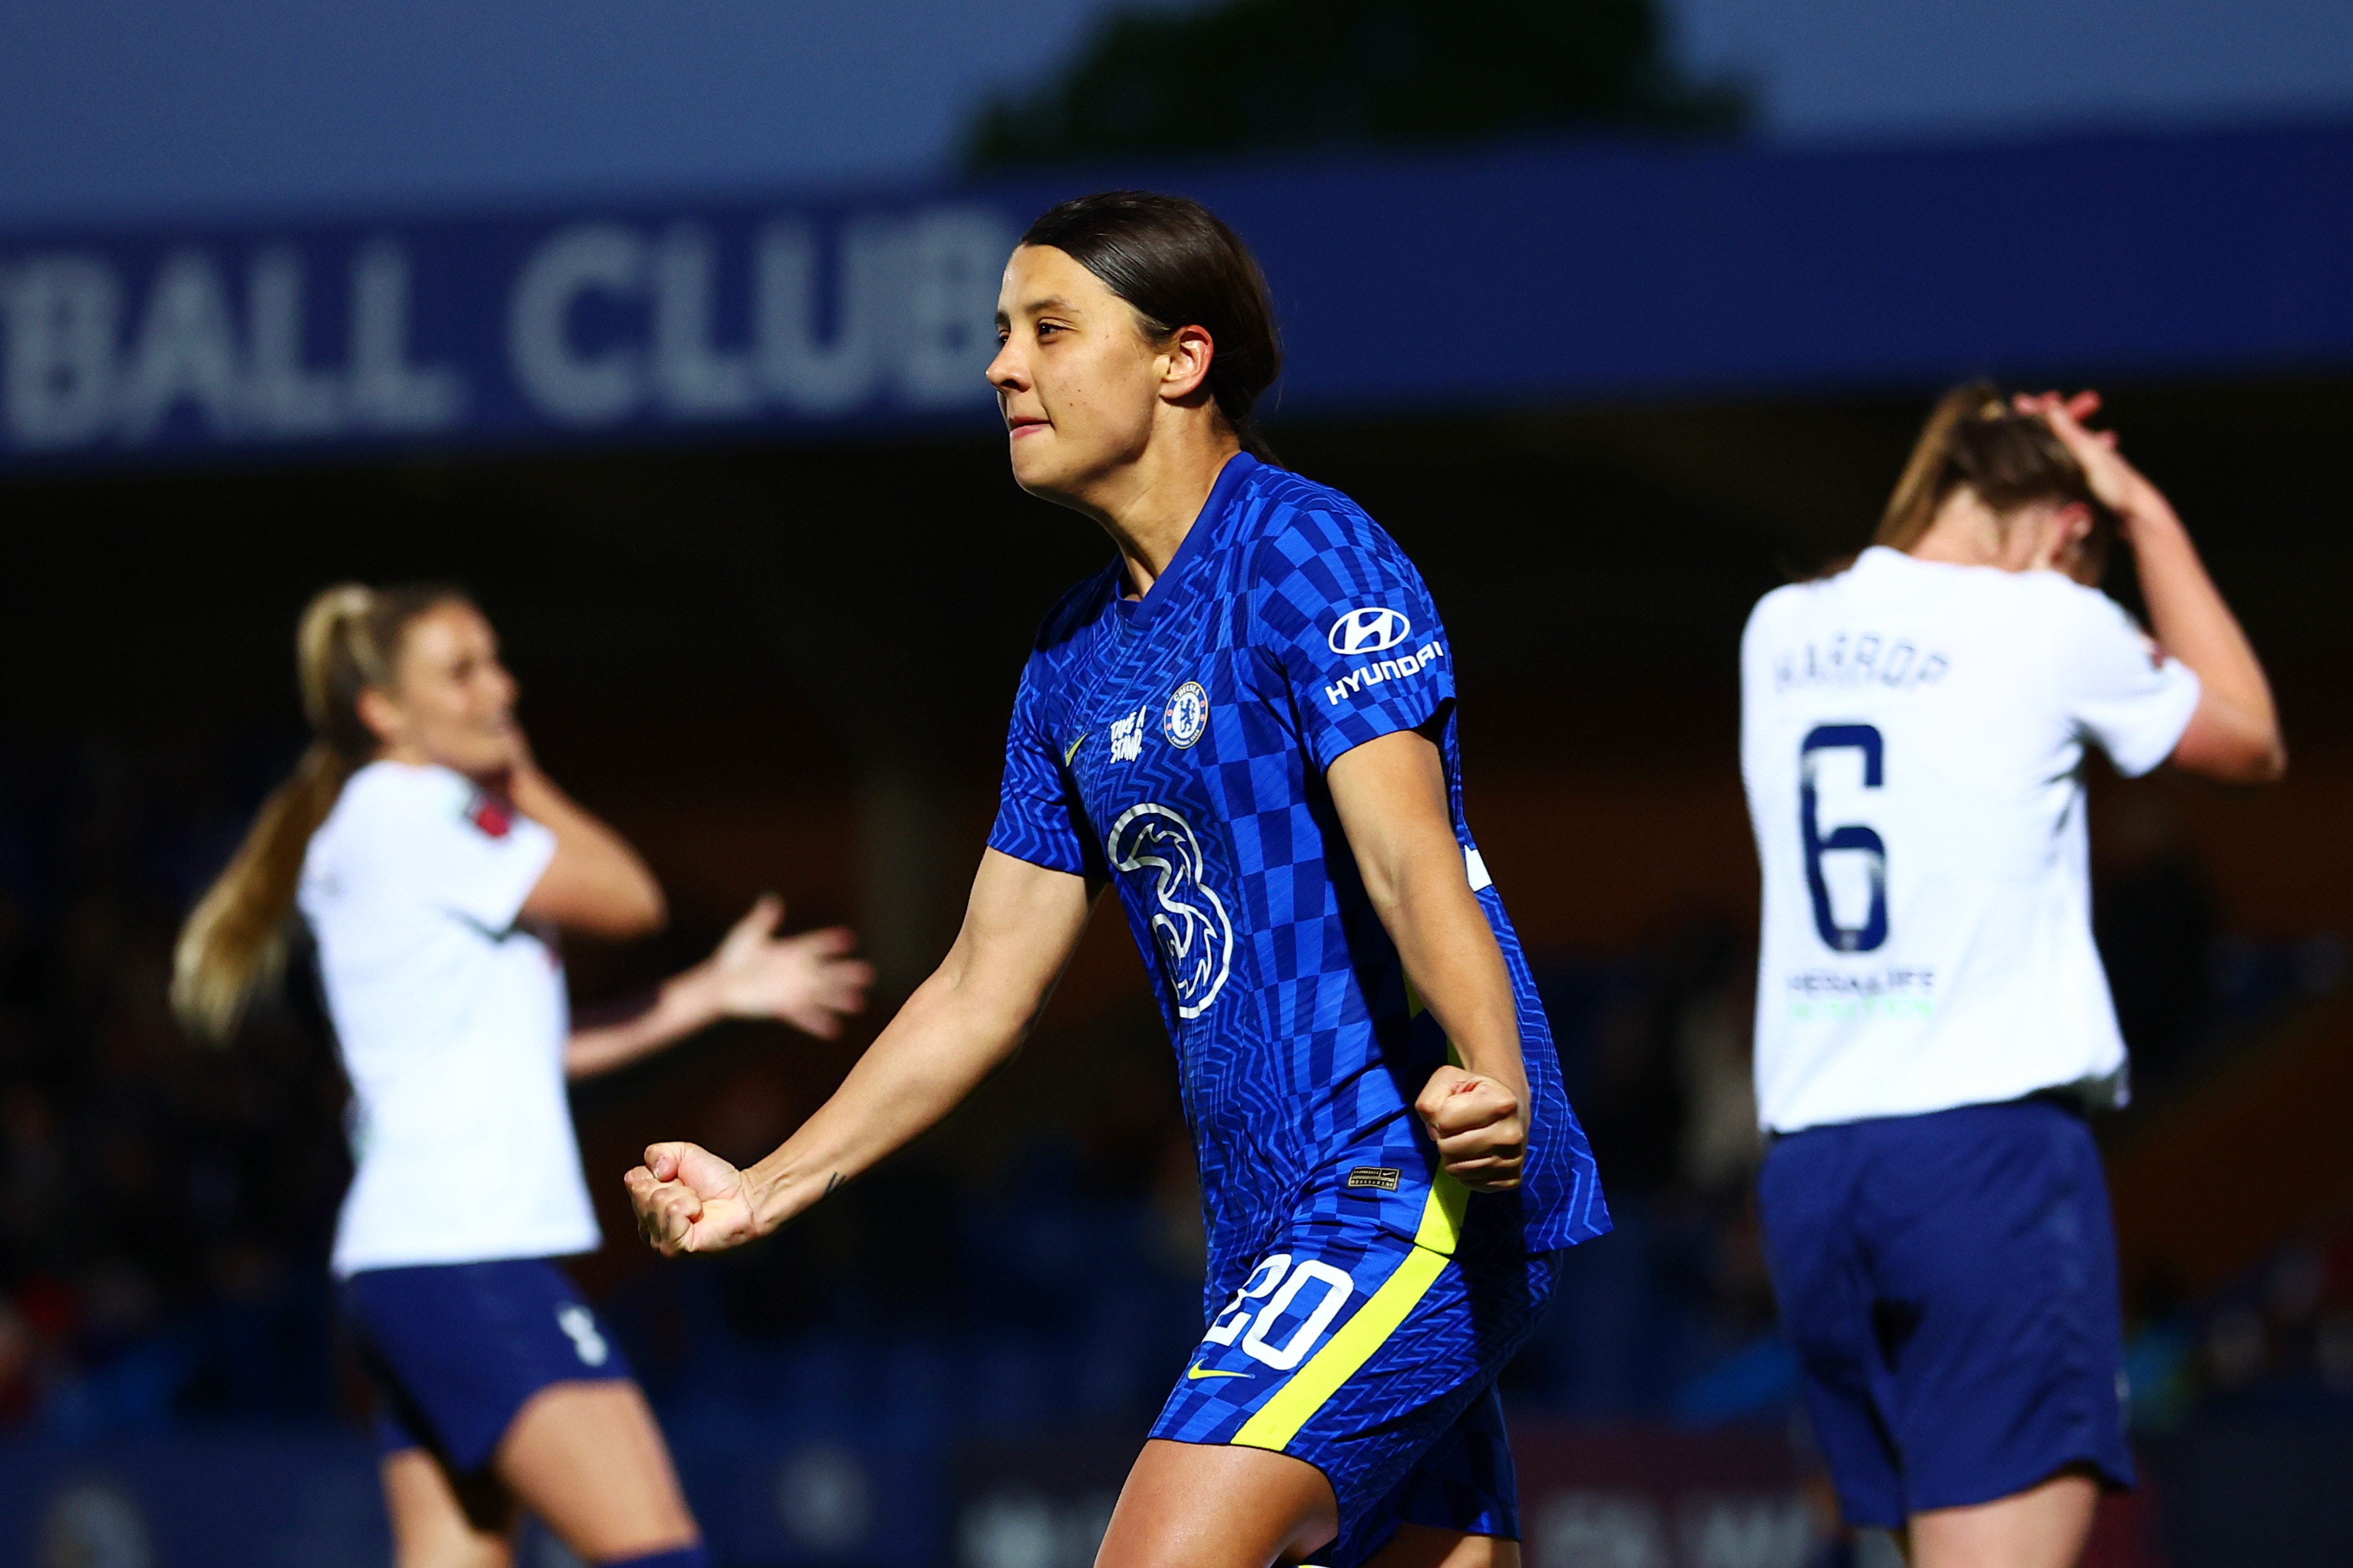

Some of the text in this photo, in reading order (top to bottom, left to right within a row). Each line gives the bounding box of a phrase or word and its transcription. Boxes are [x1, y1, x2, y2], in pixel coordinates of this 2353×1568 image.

[0, 208, 1015, 446] BALL CLUB
[1174, 684, 1200, 701] CHELSEA
[1325, 642, 1443, 705] HYUNDAI
[1110, 705, 1147, 742] TAKE A
[1801, 725, 1887, 951] 6
[1202, 1254, 1354, 1370] 20
